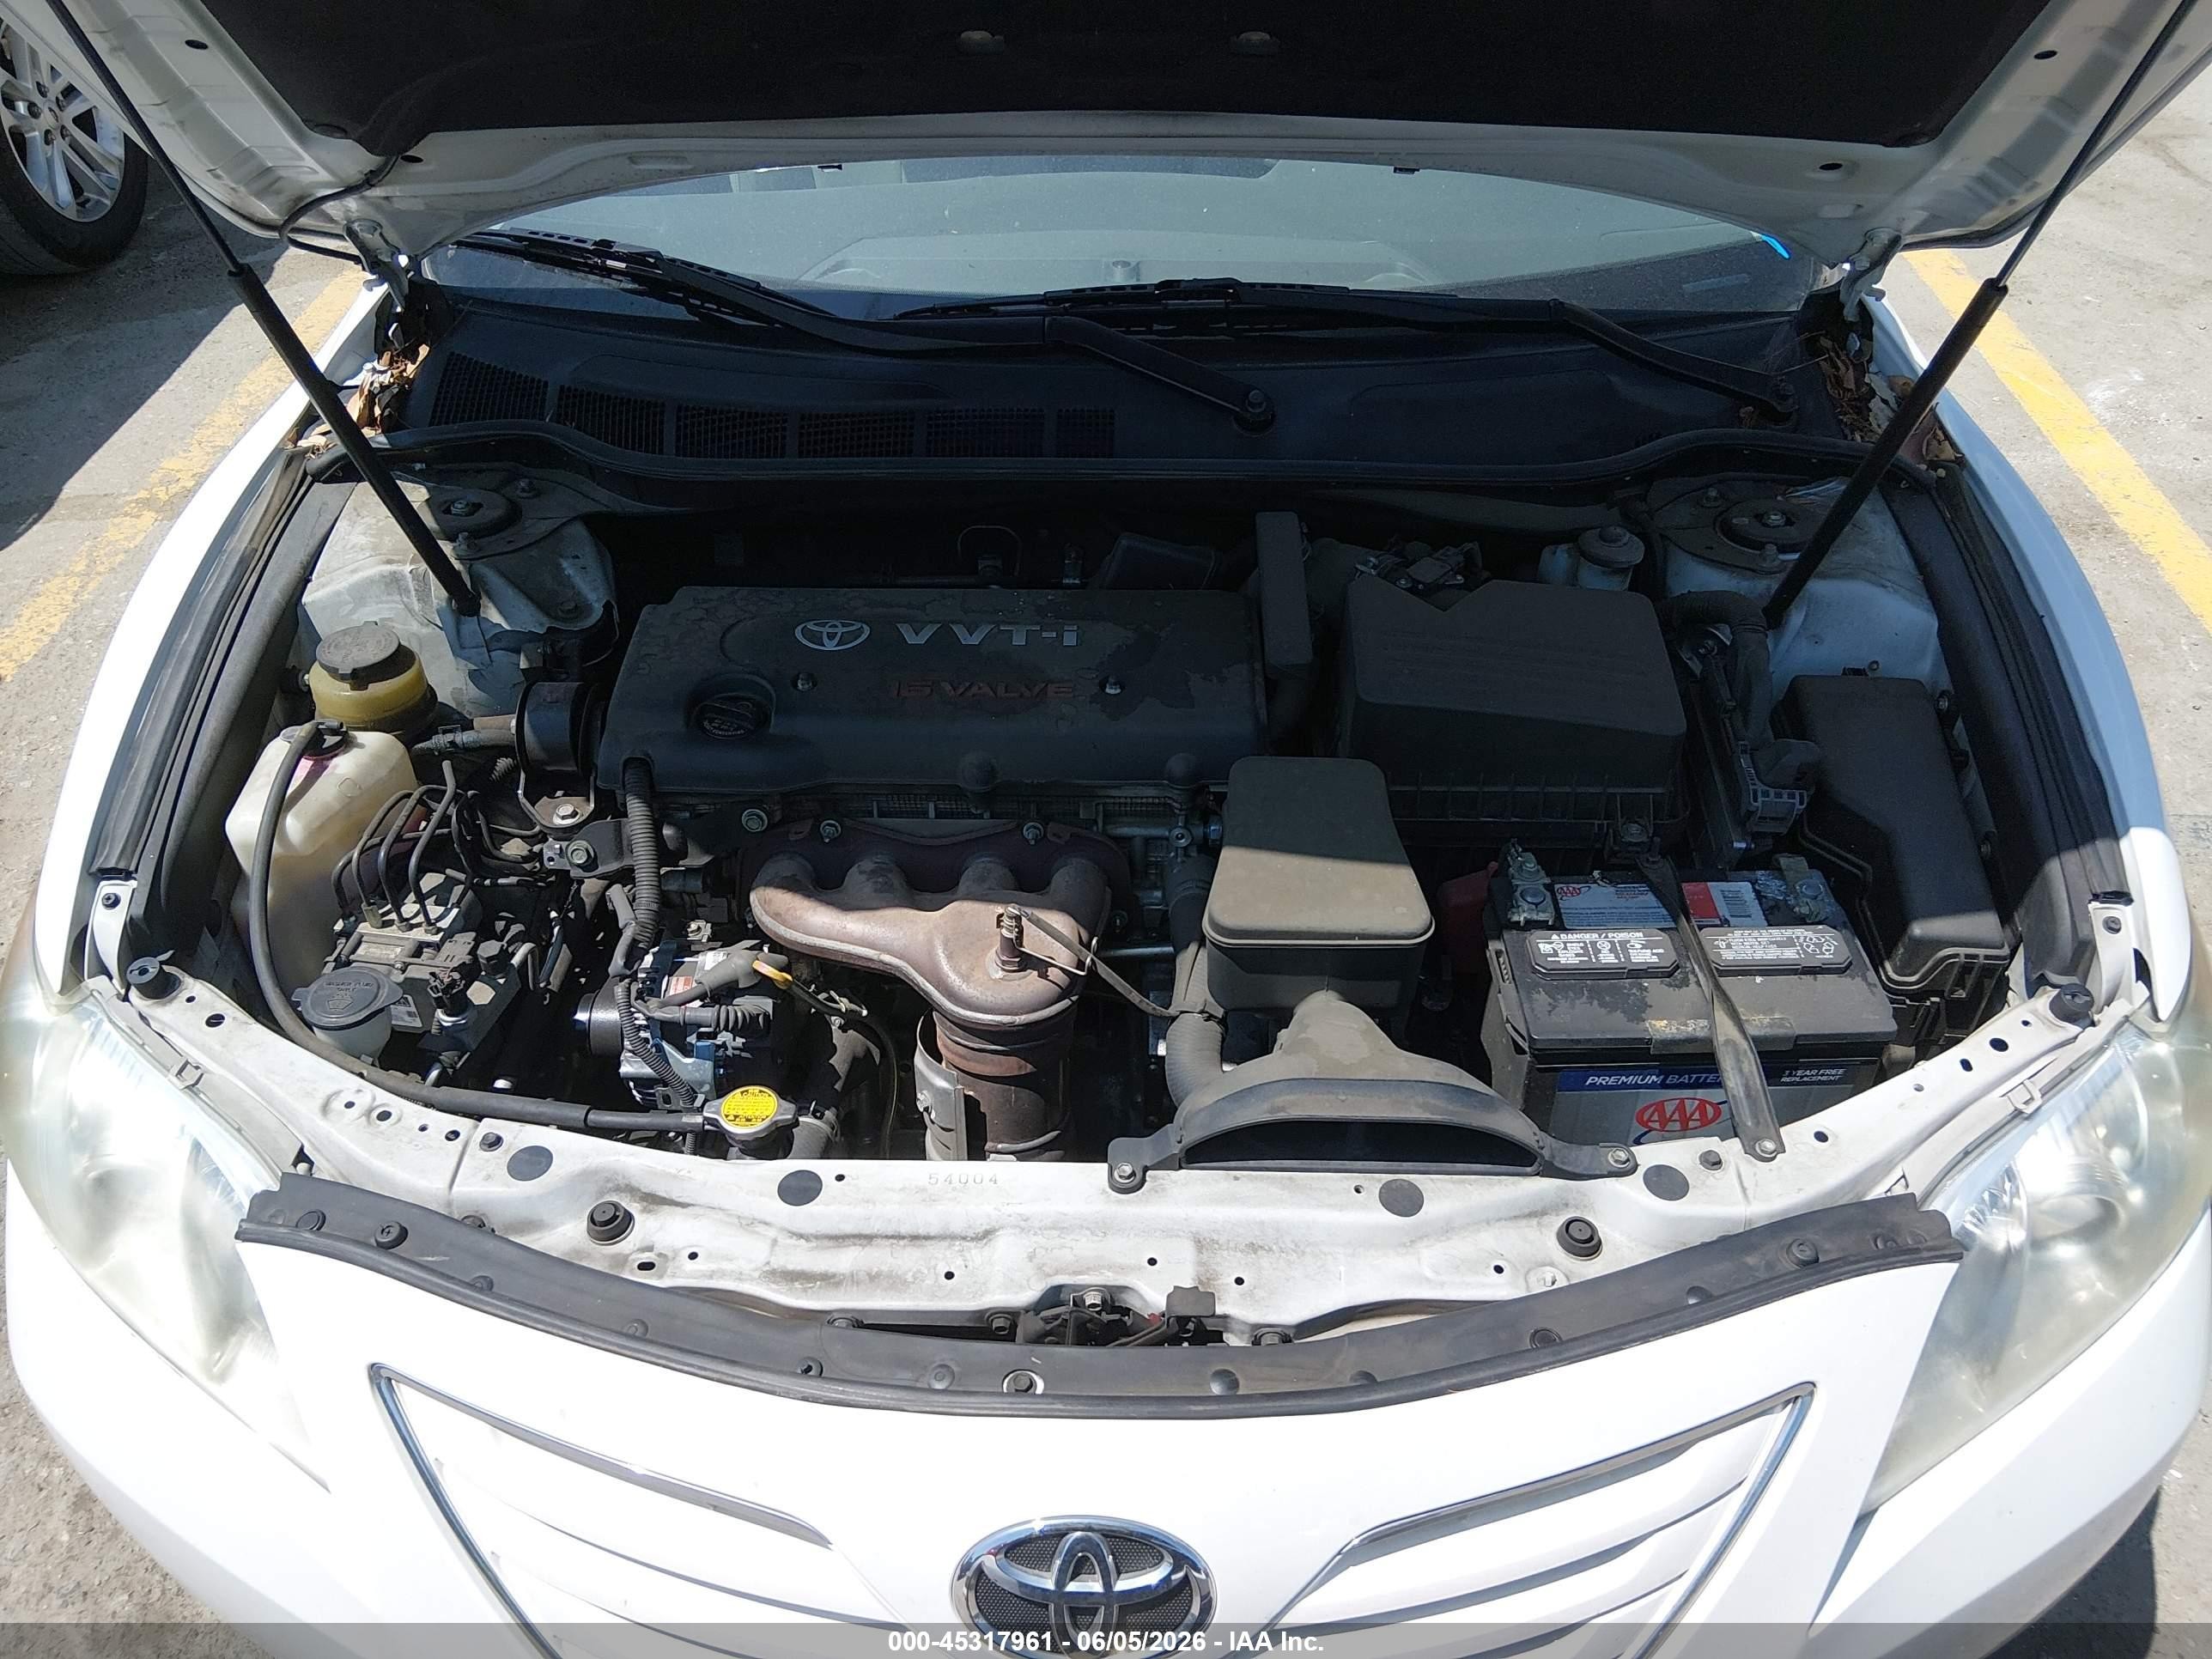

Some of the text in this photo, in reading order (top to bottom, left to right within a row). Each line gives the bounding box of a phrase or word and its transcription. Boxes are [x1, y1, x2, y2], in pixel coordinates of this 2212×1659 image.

[896, 623, 1079, 646] VVT-i
[940, 680, 1073, 699] VALVE
[1585, 1074, 1665, 1085] PREMIUM
[1642, 1098, 1714, 1131] AAA
[927, 1173, 998, 1185] 54004
